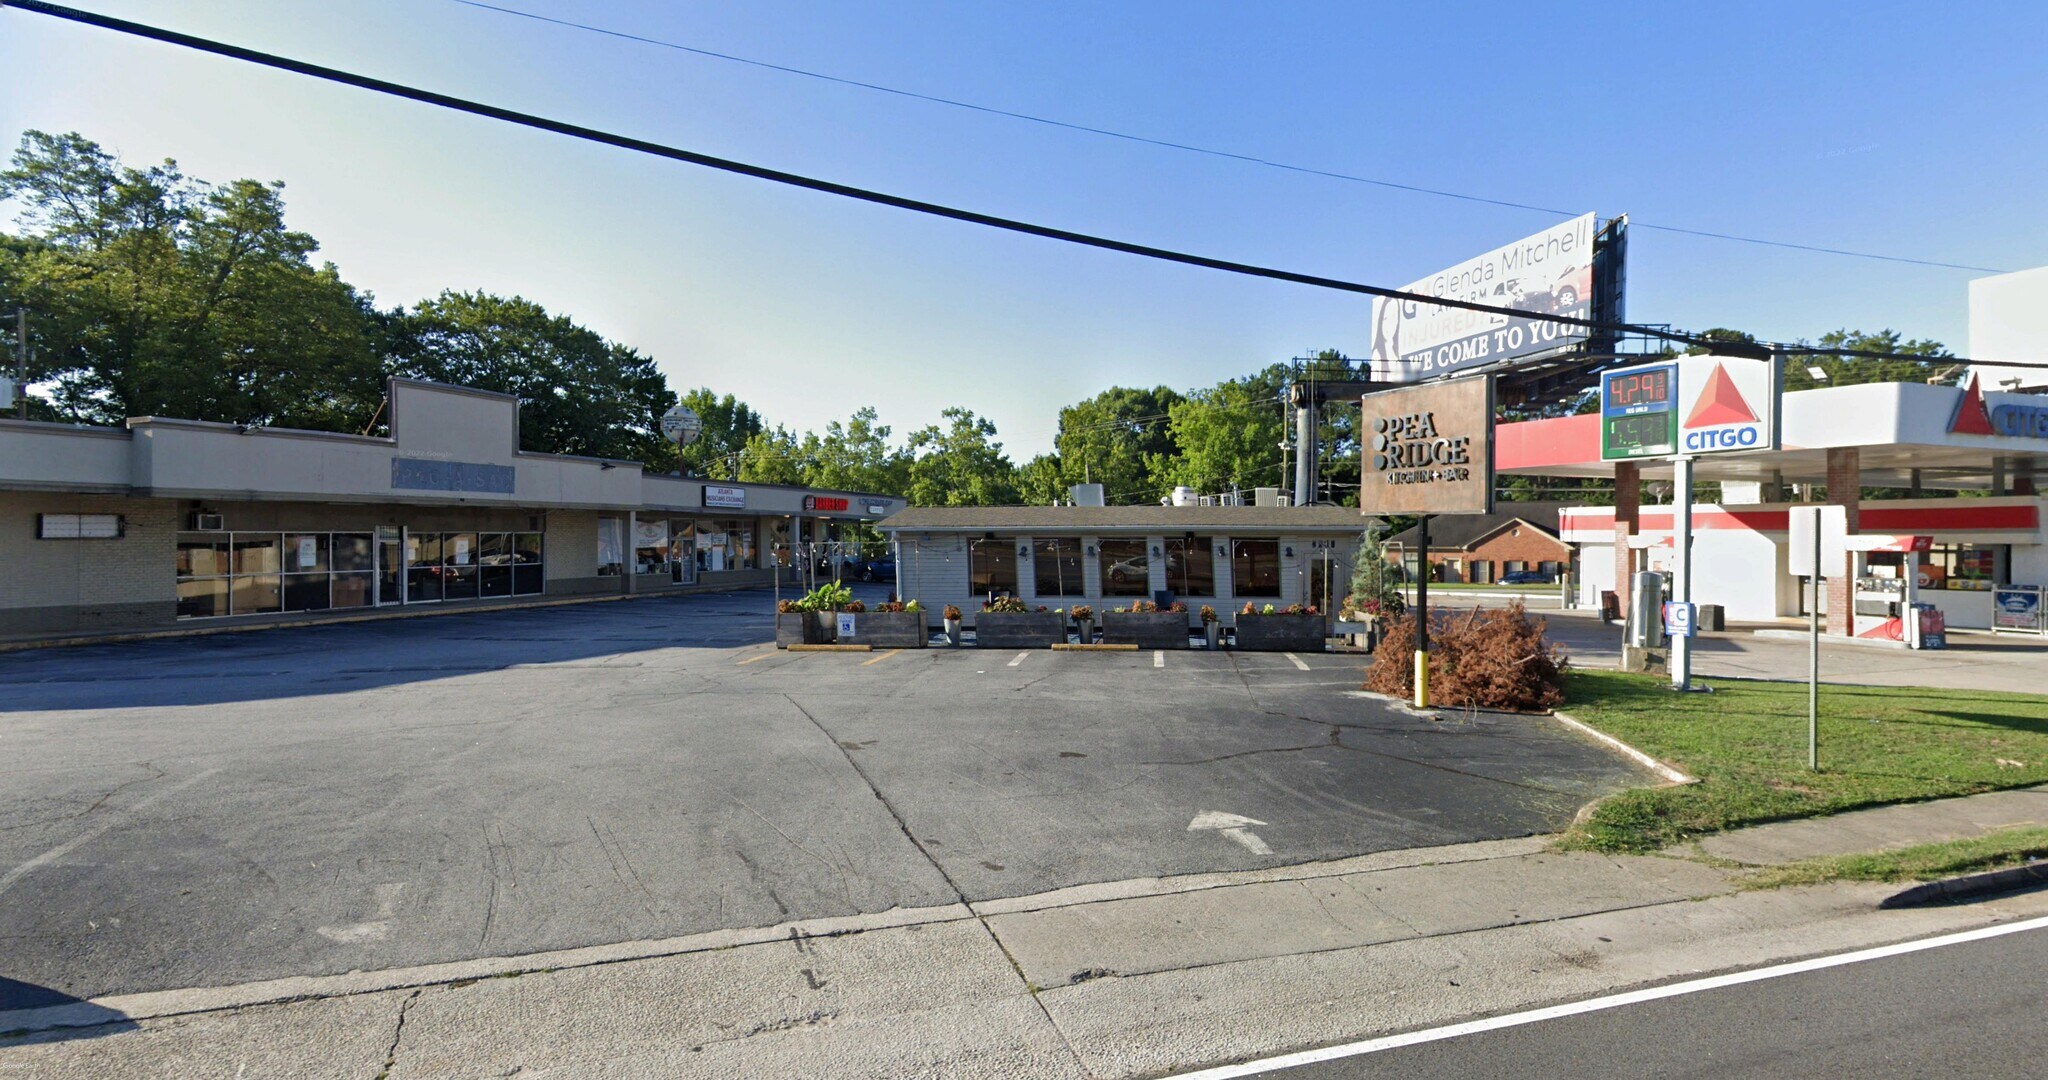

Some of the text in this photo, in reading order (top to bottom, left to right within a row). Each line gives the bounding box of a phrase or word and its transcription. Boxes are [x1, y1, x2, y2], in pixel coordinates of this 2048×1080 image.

[1433, 219, 1587, 298] Glenda Mitchell
[1458, 287, 1487, 304] FIRM
[1408, 307, 1585, 372] WE COME TO YOU!
[1610, 373, 1655, 404] 4.29
[1388, 411, 1439, 442] PEA
[1685, 426, 1758, 450] CITGO
[1387, 435, 1470, 469] RIDGE
